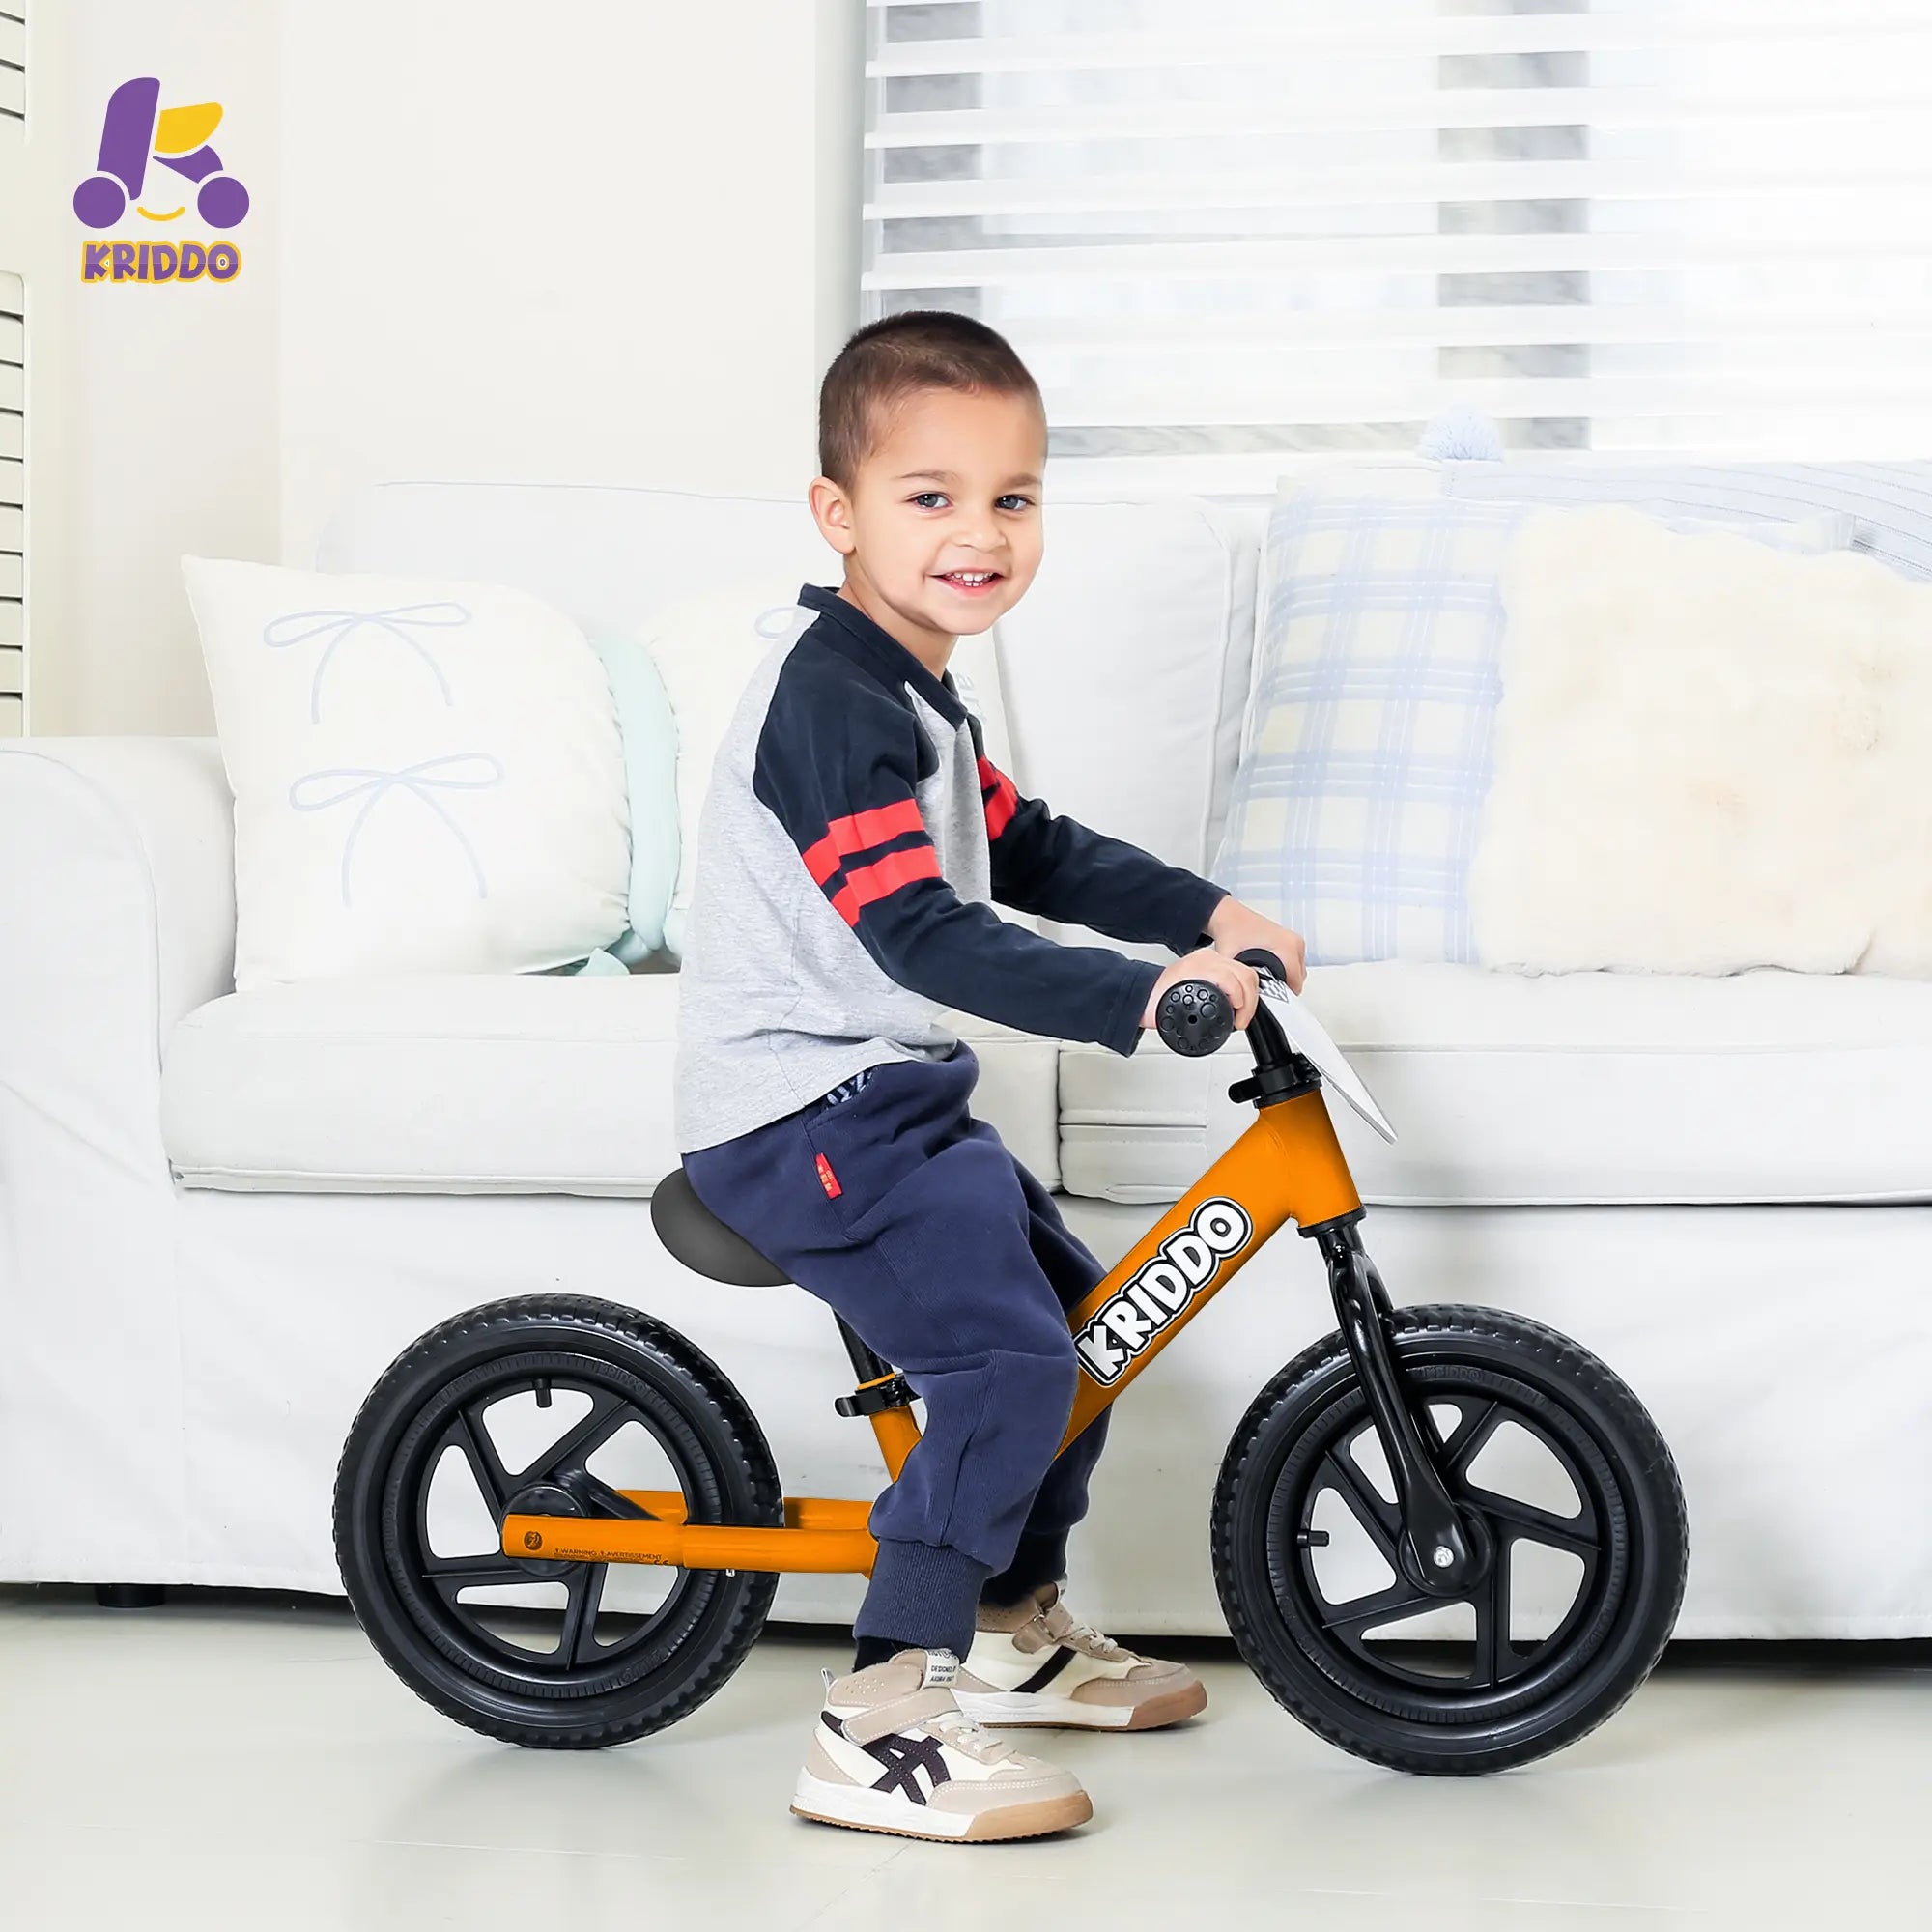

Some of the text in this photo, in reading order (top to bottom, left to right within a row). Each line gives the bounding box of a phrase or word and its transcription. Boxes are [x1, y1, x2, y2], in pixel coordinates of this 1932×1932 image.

[1074, 1198, 1250, 1381] KRIDDO
[561, 1548, 597, 1556] WARNING
[607, 1550, 663, 1560] AVERTISSEMENT
